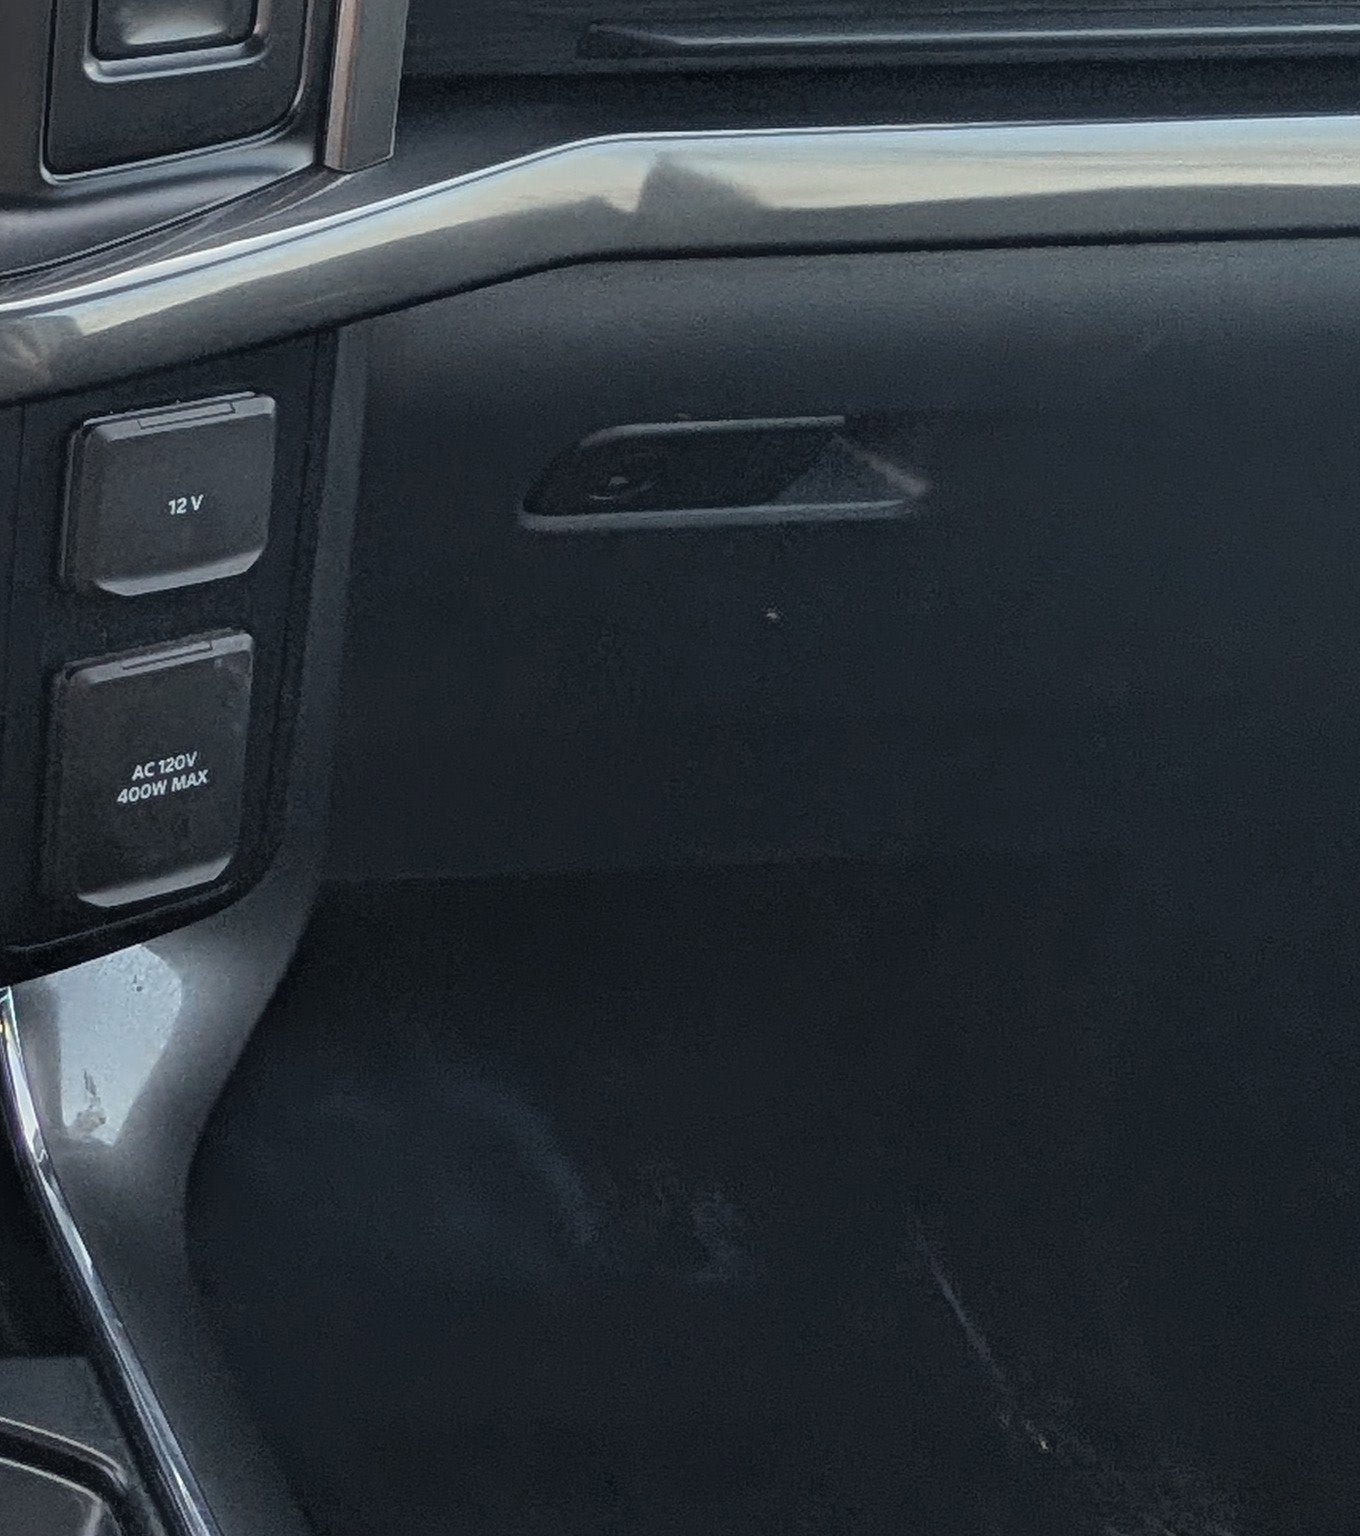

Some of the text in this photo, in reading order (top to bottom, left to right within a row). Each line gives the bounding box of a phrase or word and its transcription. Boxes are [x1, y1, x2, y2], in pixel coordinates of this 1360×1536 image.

[168, 495, 203, 515] 12 V
[132, 752, 198, 780] AC 120V
[117, 770, 209, 804] 400W MAX
